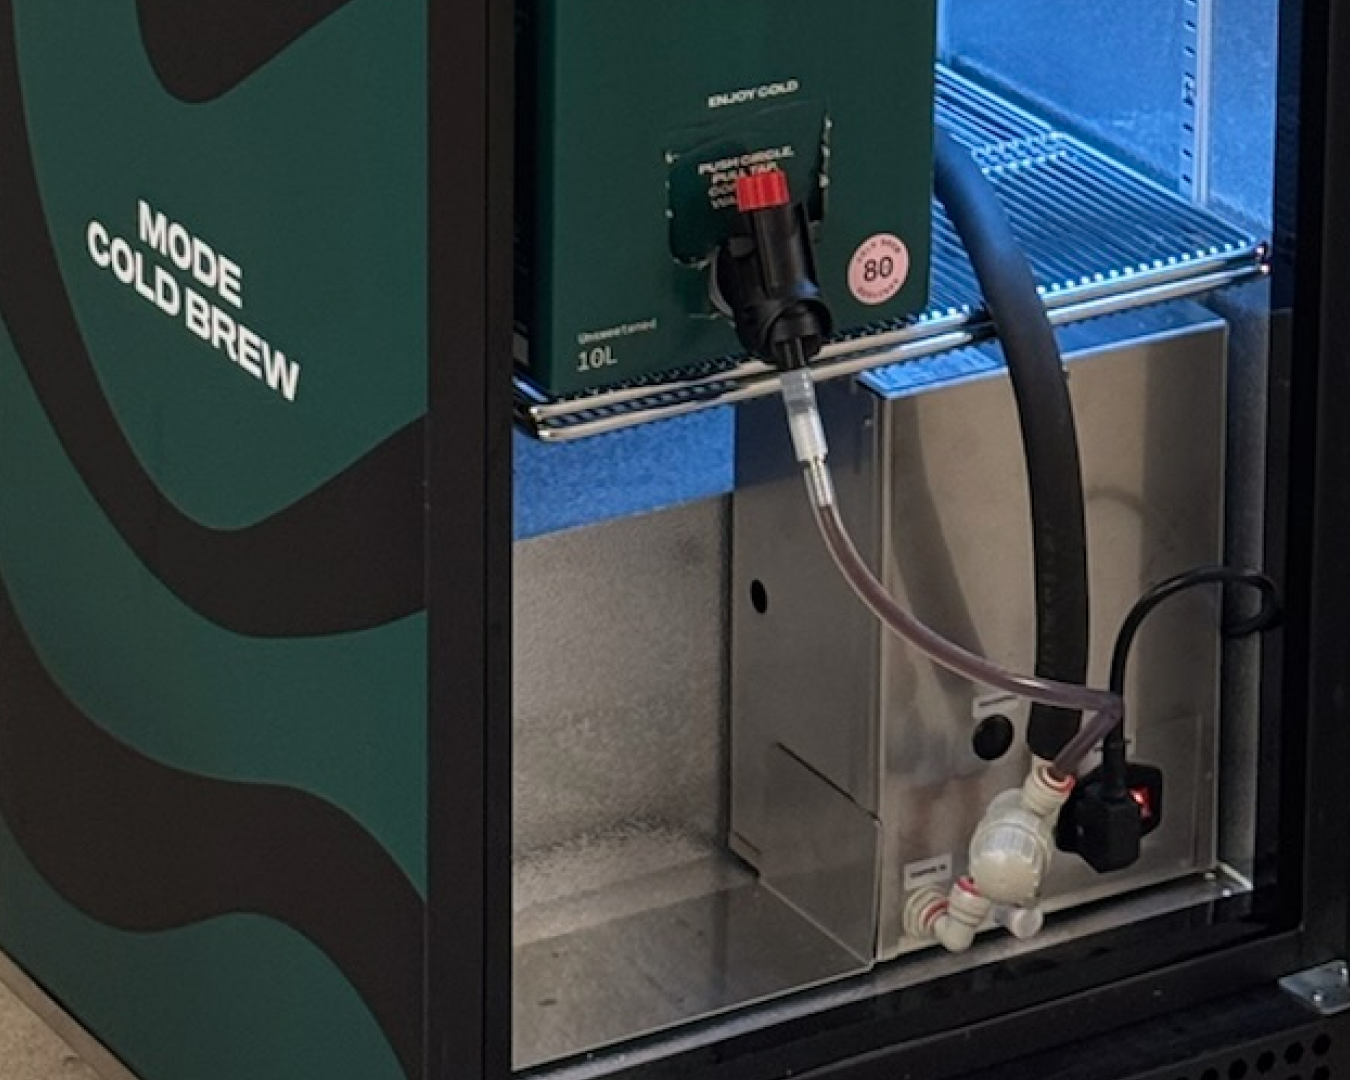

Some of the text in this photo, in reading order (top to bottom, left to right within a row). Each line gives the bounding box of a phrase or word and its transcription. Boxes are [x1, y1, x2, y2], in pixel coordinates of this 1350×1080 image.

[708, 79, 799, 108] ENJOY COLD
[137, 199, 243, 309] MODE
[864, 256, 894, 281] 80
[87, 221, 300, 401] COLD BREW
[576, 345, 618, 373] 10L
